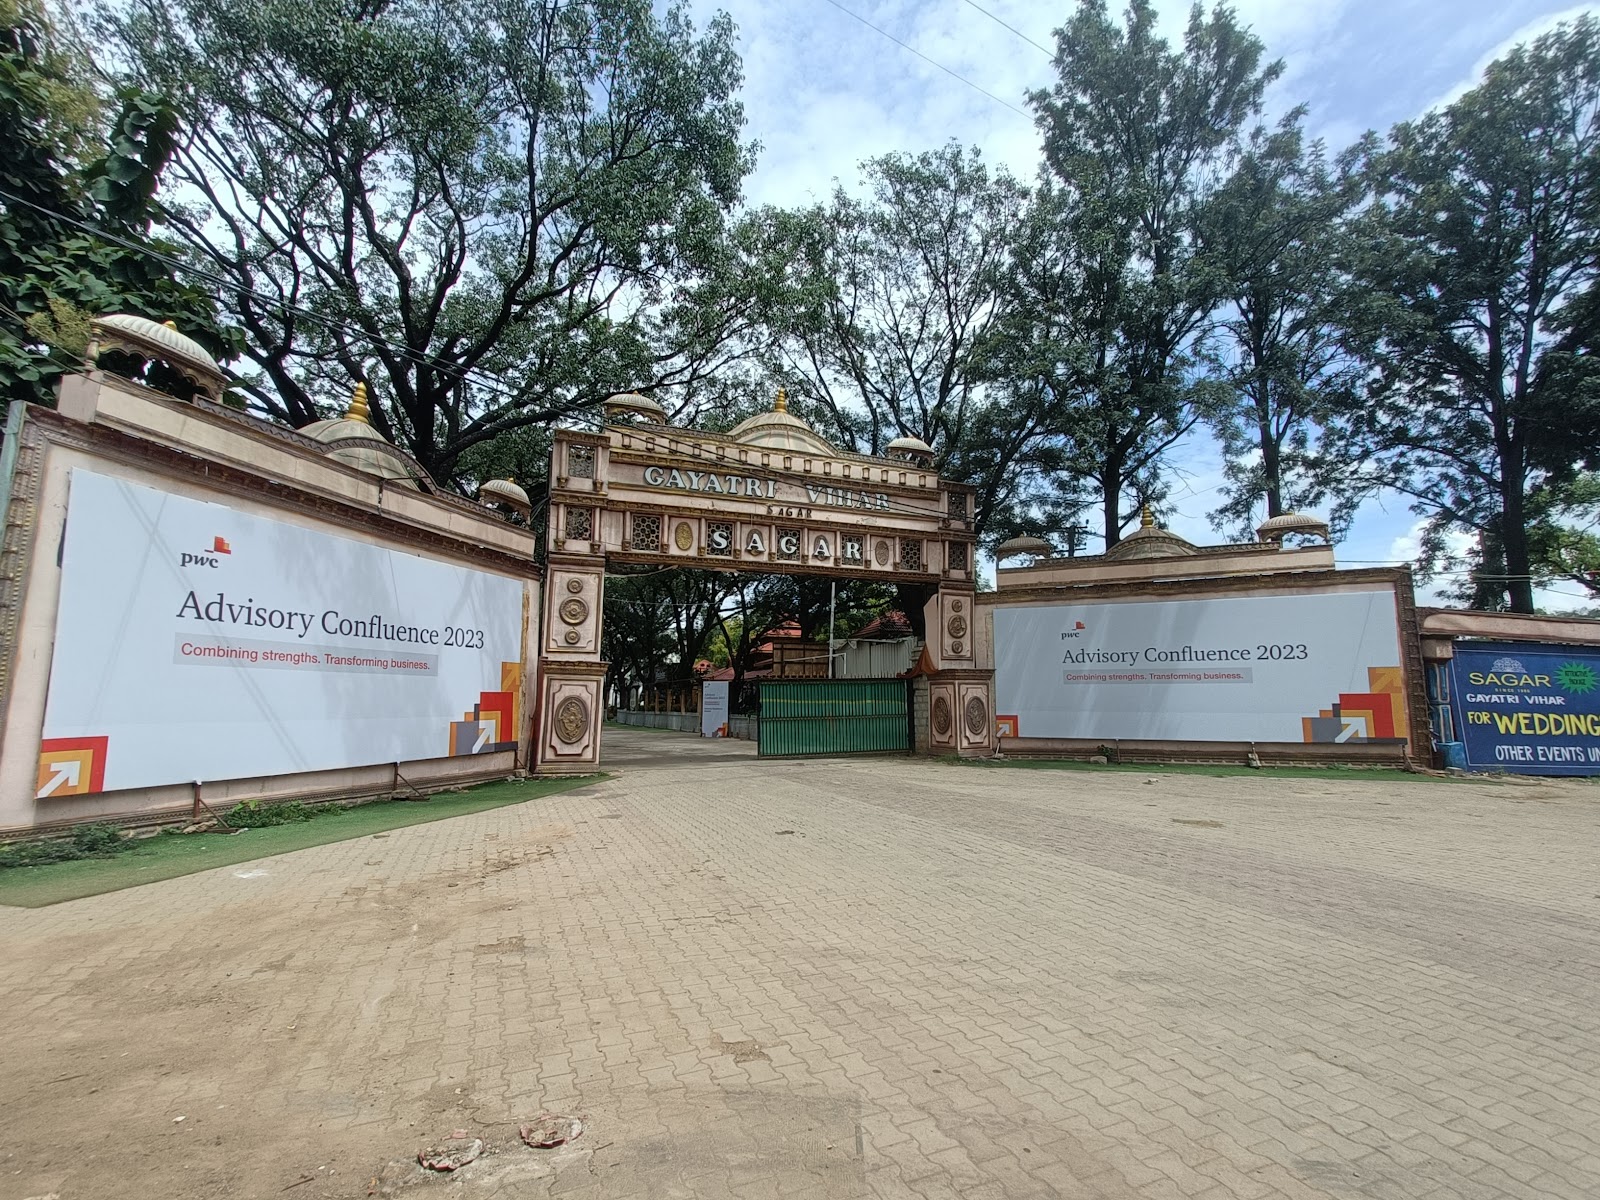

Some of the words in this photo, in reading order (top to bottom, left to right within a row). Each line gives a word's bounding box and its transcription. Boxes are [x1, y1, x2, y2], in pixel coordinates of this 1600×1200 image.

[643, 466, 776, 499] GAYATRI
[805, 484, 891, 511] VIHAR
[767, 504, 812, 519] SAGAR
[712, 530, 862, 561] SAGAR
[180, 551, 219, 569] pwc
[176, 590, 315, 638] Advisory
[321, 610, 440, 645] Confluence
[443, 626, 485, 650] 2023
[1061, 631, 1080, 640] pwc
[180, 642, 258, 662] Combining
[261, 649, 321, 666] strengths.
[324, 653, 389, 670] Transforming
[390, 657, 430, 671] business.
[1062, 648, 1140, 666] Advisory
[1144, 646, 1252, 663] Confluence
[1256, 644, 1308, 661] 2023
[1065, 673, 1107, 682] Combining
[1107, 673, 1147, 682] strengths.
[1149, 673, 1202, 681] Transforming
[1203, 672, 1244, 680] business.
[1469, 672, 1552, 688] SAGAR
[1466, 693, 1520, 704] GAYATRI
[1524, 695, 1566, 705] VIHAR
[1467, 711, 1492, 725] FOR
[1493, 712, 1600, 737] WEDDING
[1495, 745, 1534, 761] OTHER
[1537, 746, 1586, 762] EVENTS
